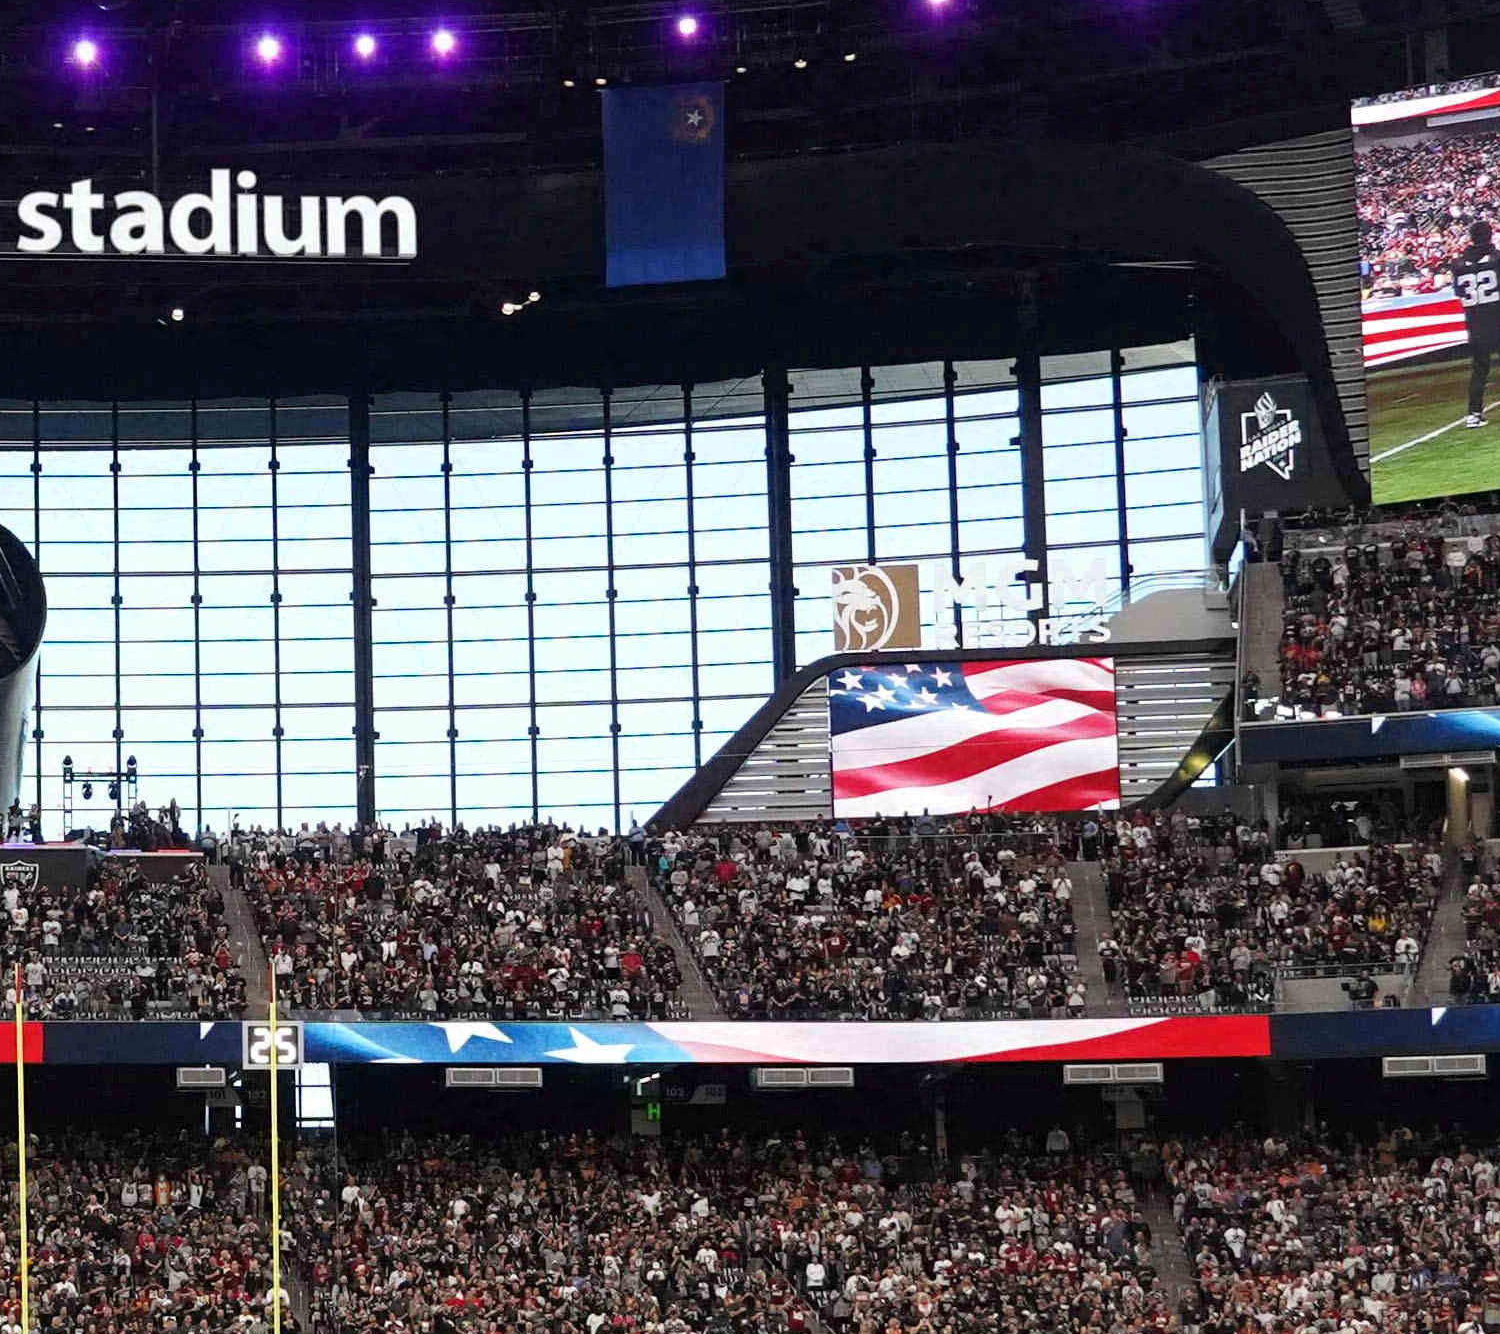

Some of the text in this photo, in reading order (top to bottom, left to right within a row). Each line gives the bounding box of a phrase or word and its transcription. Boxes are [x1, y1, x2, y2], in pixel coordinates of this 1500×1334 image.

[16, 168, 418, 259] stadium
[1457, 270, 1500, 308] 32
[1241, 431, 1302, 472] NATION
[935, 557, 1105, 612] MGM
[936, 616, 1111, 649] RESORTS
[250, 1027, 297, 1064] 25
